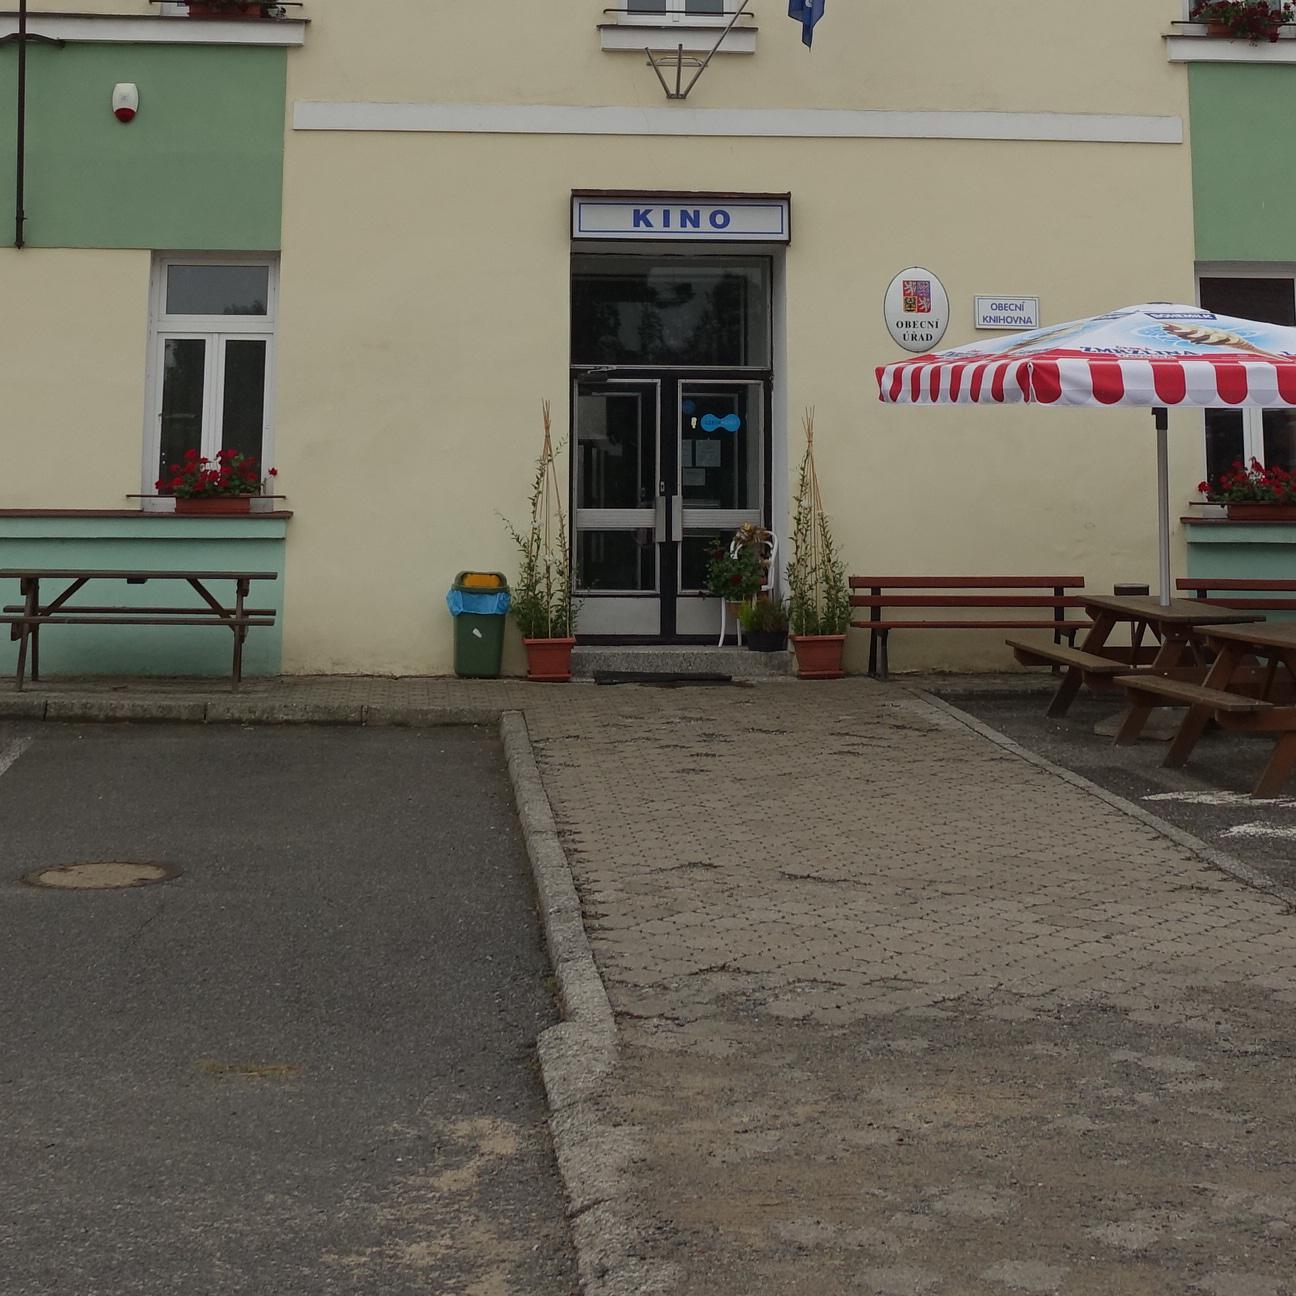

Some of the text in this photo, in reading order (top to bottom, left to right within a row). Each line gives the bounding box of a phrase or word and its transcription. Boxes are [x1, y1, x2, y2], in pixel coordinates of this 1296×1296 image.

[632, 208, 731, 229] KINO
[990, 301, 1026, 312] OBECNÍ
[896, 318, 940, 329] OBECNÍ
[982, 315, 1033, 325] KNIHOVNA
[903, 330, 934, 342] ÚŘAD
